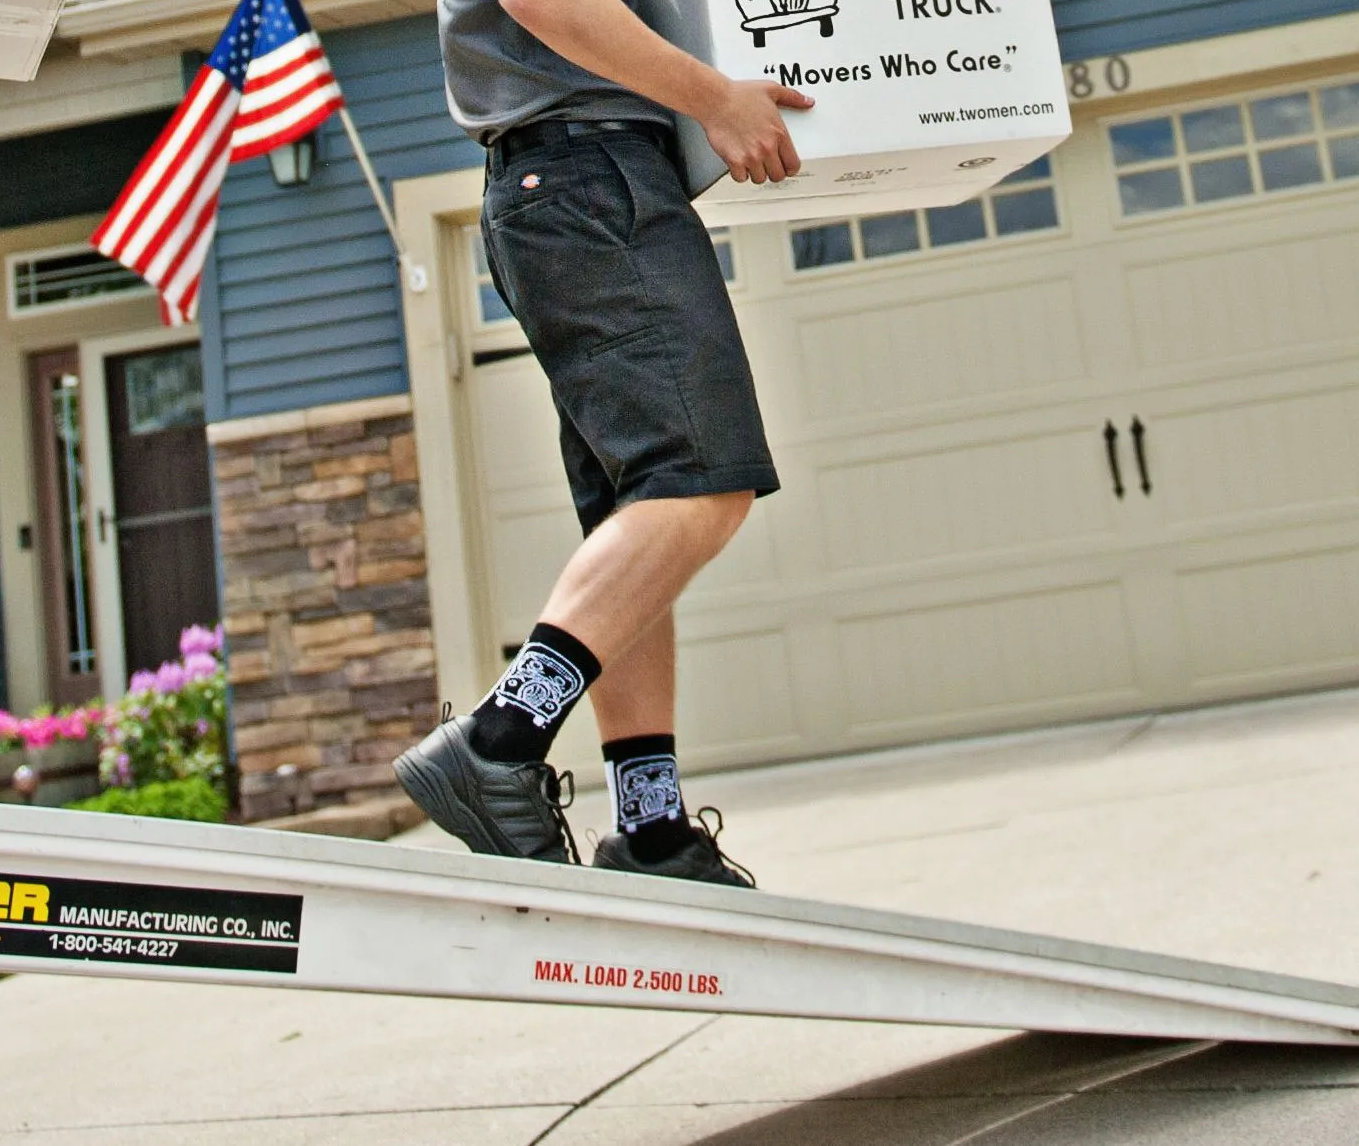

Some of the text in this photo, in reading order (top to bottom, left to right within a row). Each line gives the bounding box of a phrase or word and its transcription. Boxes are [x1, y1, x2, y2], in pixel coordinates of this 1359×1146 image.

[880, 54, 936, 78] Who
[1069, 56, 1130, 98] 80
[919, 103, 1053, 124] www.twomen.com
[59, 907, 295, 941] MANUFACTURING CO., INC.
[50, 934, 179, 956] 1-800-541-4227
[535, 961, 577, 983] MAX.
[585, 966, 627, 986] LOAD
[688, 974, 723, 994] LBS.
